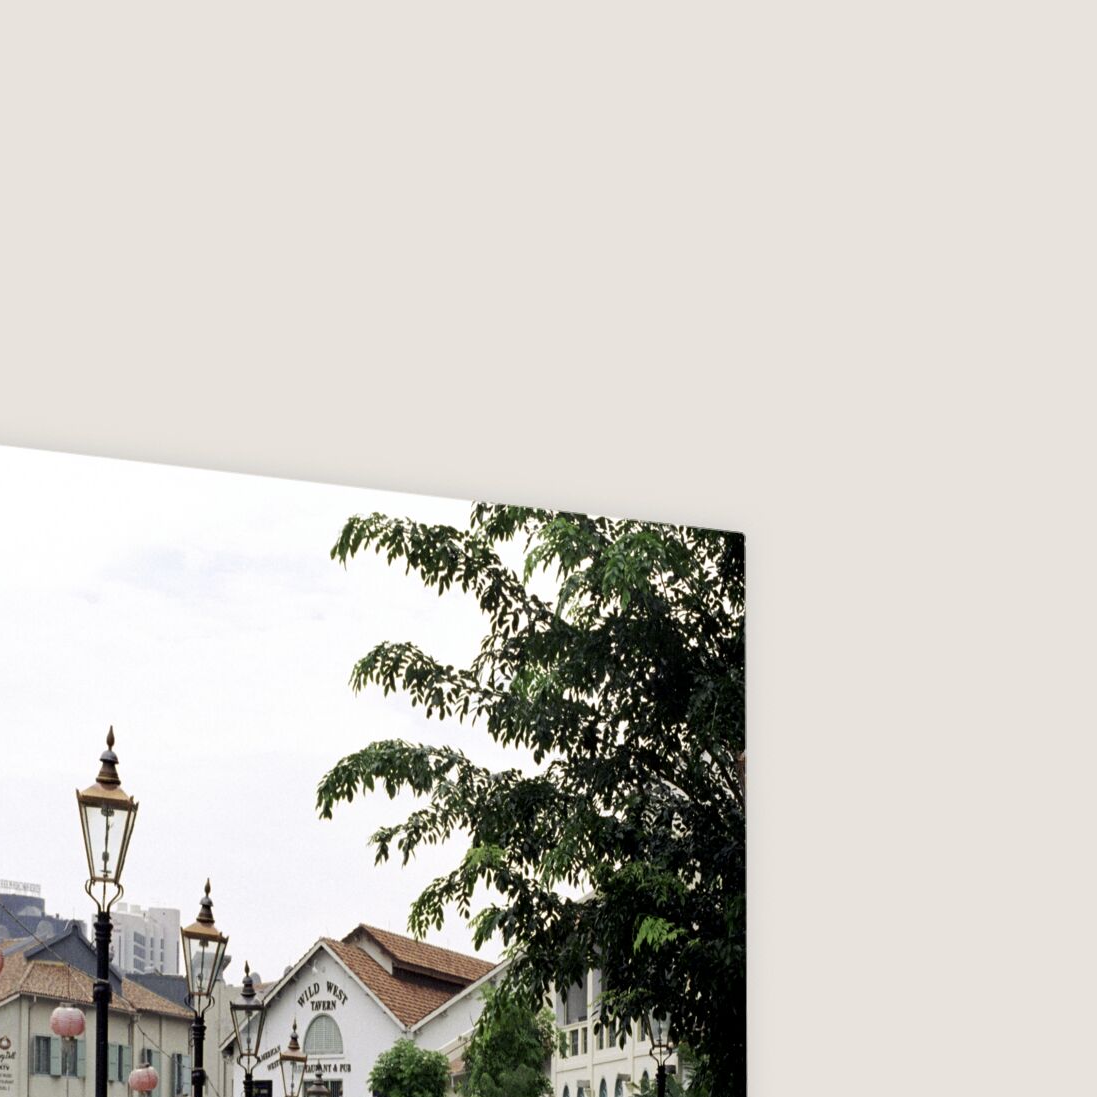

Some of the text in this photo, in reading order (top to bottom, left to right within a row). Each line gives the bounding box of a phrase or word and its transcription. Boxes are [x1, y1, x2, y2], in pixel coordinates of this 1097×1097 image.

[297, 981, 349, 1008] WILD WEST
[310, 1000, 337, 1012] TAVERN
[339, 1063, 352, 1073] PUB
